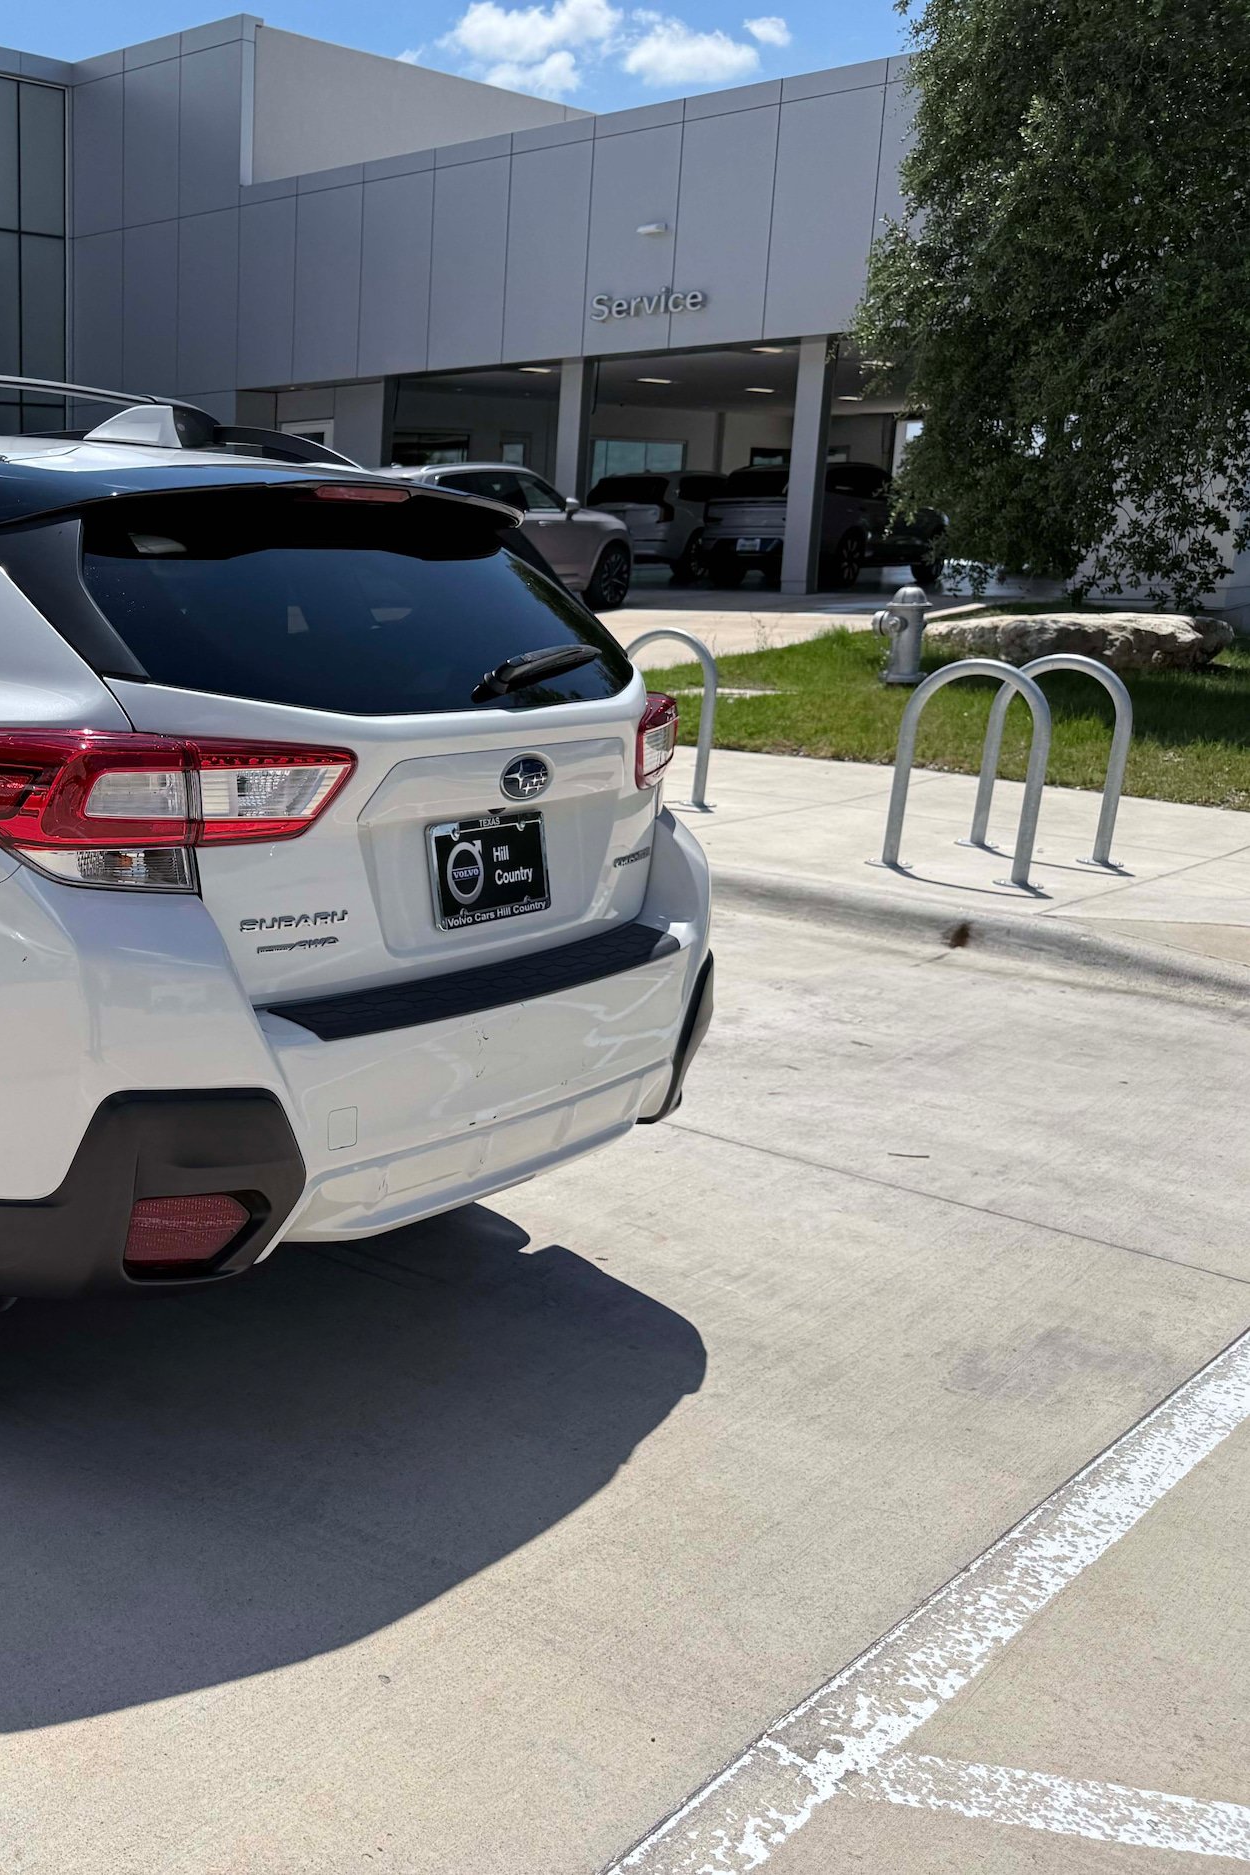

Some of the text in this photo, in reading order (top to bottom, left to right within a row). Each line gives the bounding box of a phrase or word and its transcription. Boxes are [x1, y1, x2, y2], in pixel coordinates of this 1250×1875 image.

[591, 286, 703, 320] Service
[479, 817, 500, 828] TEXAS
[493, 845, 509, 862] Hill
[453, 868, 478, 879] VOLVO
[495, 867, 533, 885] Country
[240, 909, 348, 933] SUBARU
[448, 901, 546, 927] Volvo Cars Hill Country
